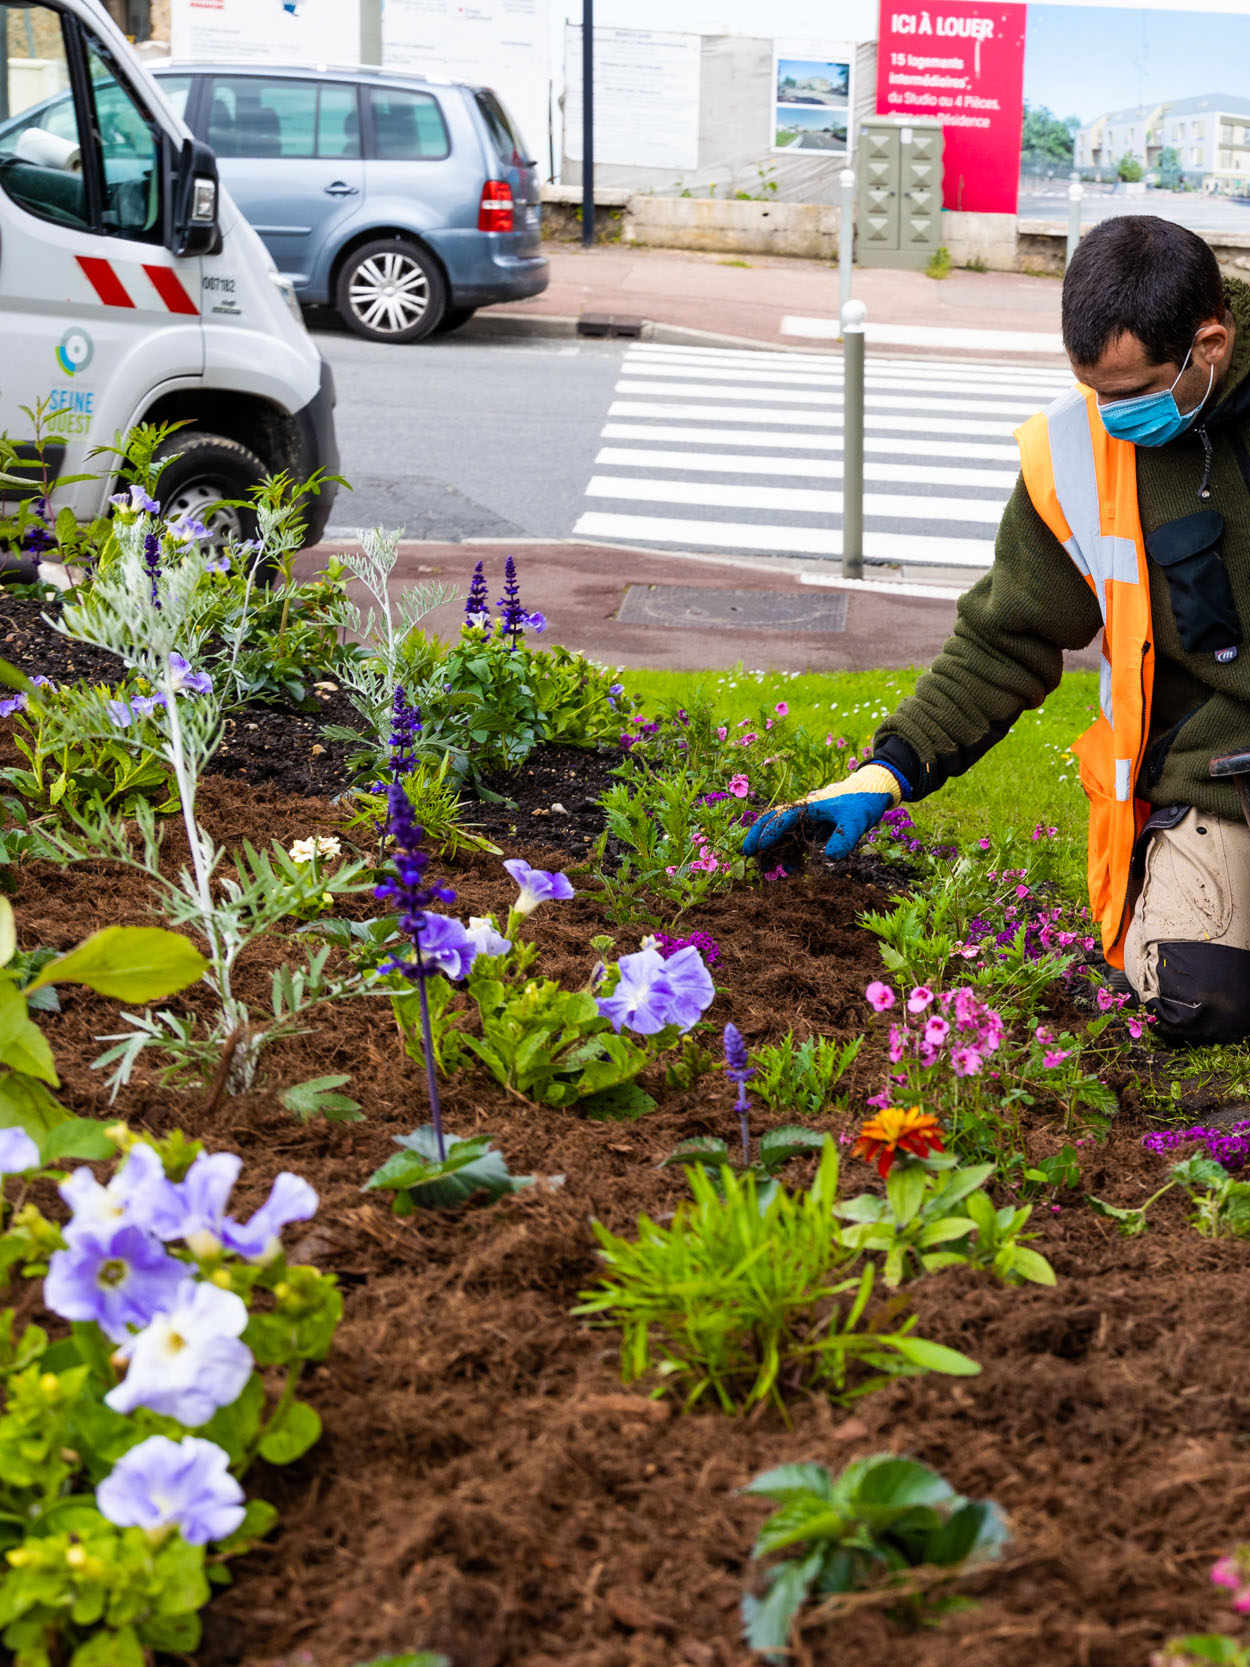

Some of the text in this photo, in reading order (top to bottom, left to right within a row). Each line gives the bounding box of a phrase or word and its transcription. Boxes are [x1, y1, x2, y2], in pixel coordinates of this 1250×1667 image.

[891, 11, 994, 39] ICI À LOUER
[890, 53, 964, 70] 15 logements
[887, 91, 903, 103] du
[904, 91, 937, 106] Studio
[938, 97, 953, 107] au
[955, 95, 963, 107] 4
[49, 389, 94, 413] SEINE
